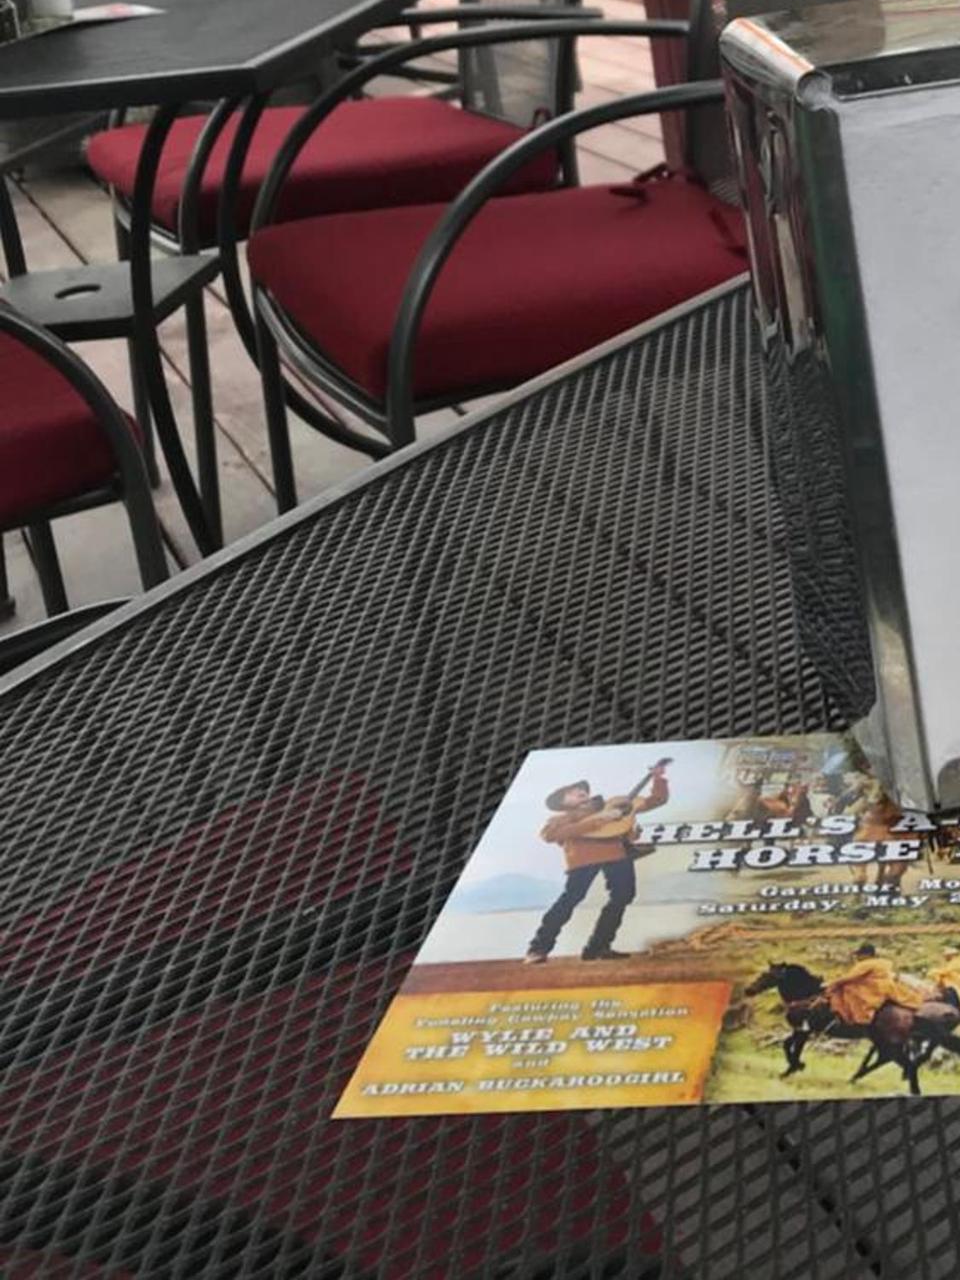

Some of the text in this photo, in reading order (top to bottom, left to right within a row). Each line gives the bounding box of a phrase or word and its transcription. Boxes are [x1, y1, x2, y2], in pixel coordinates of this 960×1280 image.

[634, 814, 858, 844] HELL'S
[689, 839, 922, 871] HORSE
[863, 894, 929, 910] May
[451, 1024, 637, 1044] WYLIE AND
[405, 1035, 672, 1060] THE WILD WEST
[362, 1081, 465, 1096] ADRIAN
